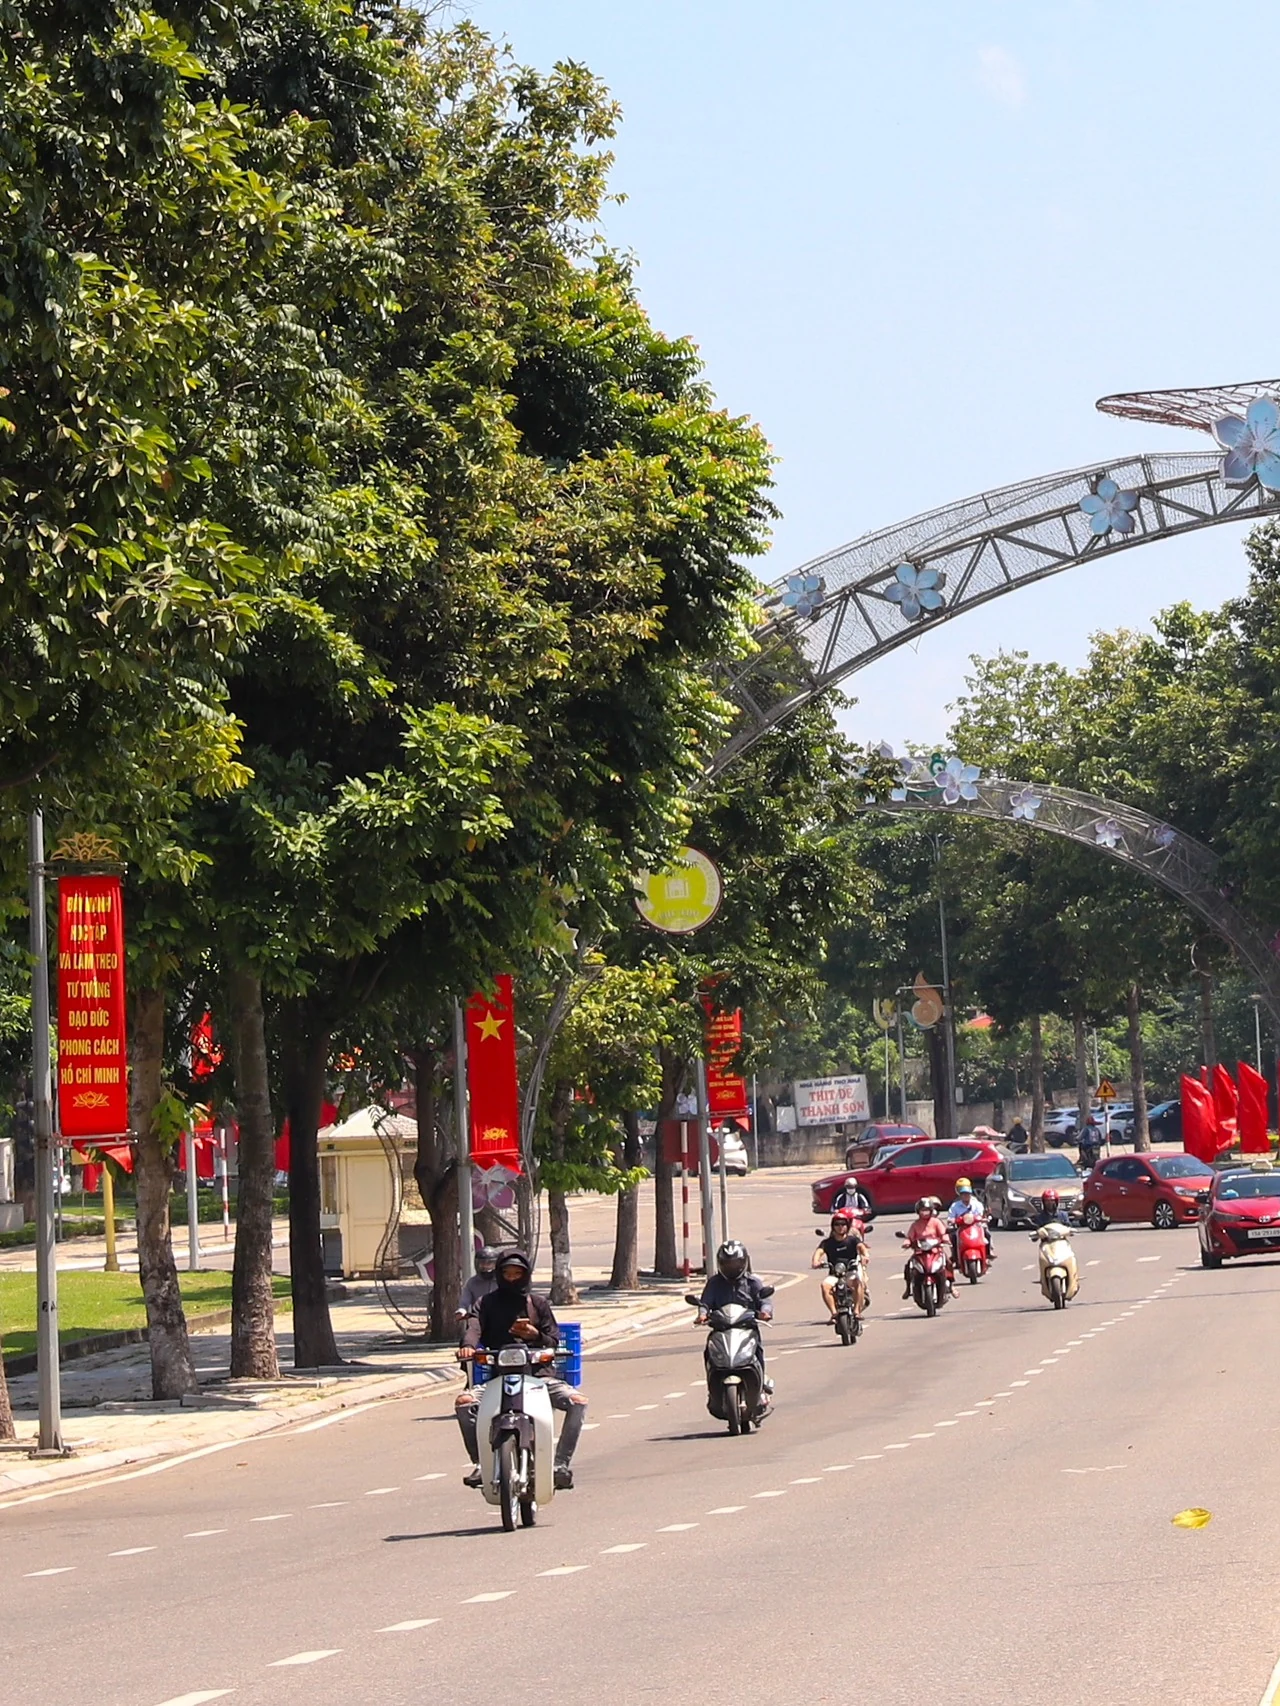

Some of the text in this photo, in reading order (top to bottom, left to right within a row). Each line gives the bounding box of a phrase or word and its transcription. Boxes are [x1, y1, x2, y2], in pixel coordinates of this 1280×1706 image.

[70, 922, 107, 944] HỌC TẬP
[60, 950, 118, 970] VÀ LÀM THEO
[67, 976, 110, 998] TƯ TƯỞNG
[69, 1007, 109, 1030] ĐẠO ĐỨC
[60, 1036, 119, 1056] PHONG CÁCH
[61, 1062, 119, 1084] HỒ CHÍ MINH
[800, 1103, 840, 1117] THANH
